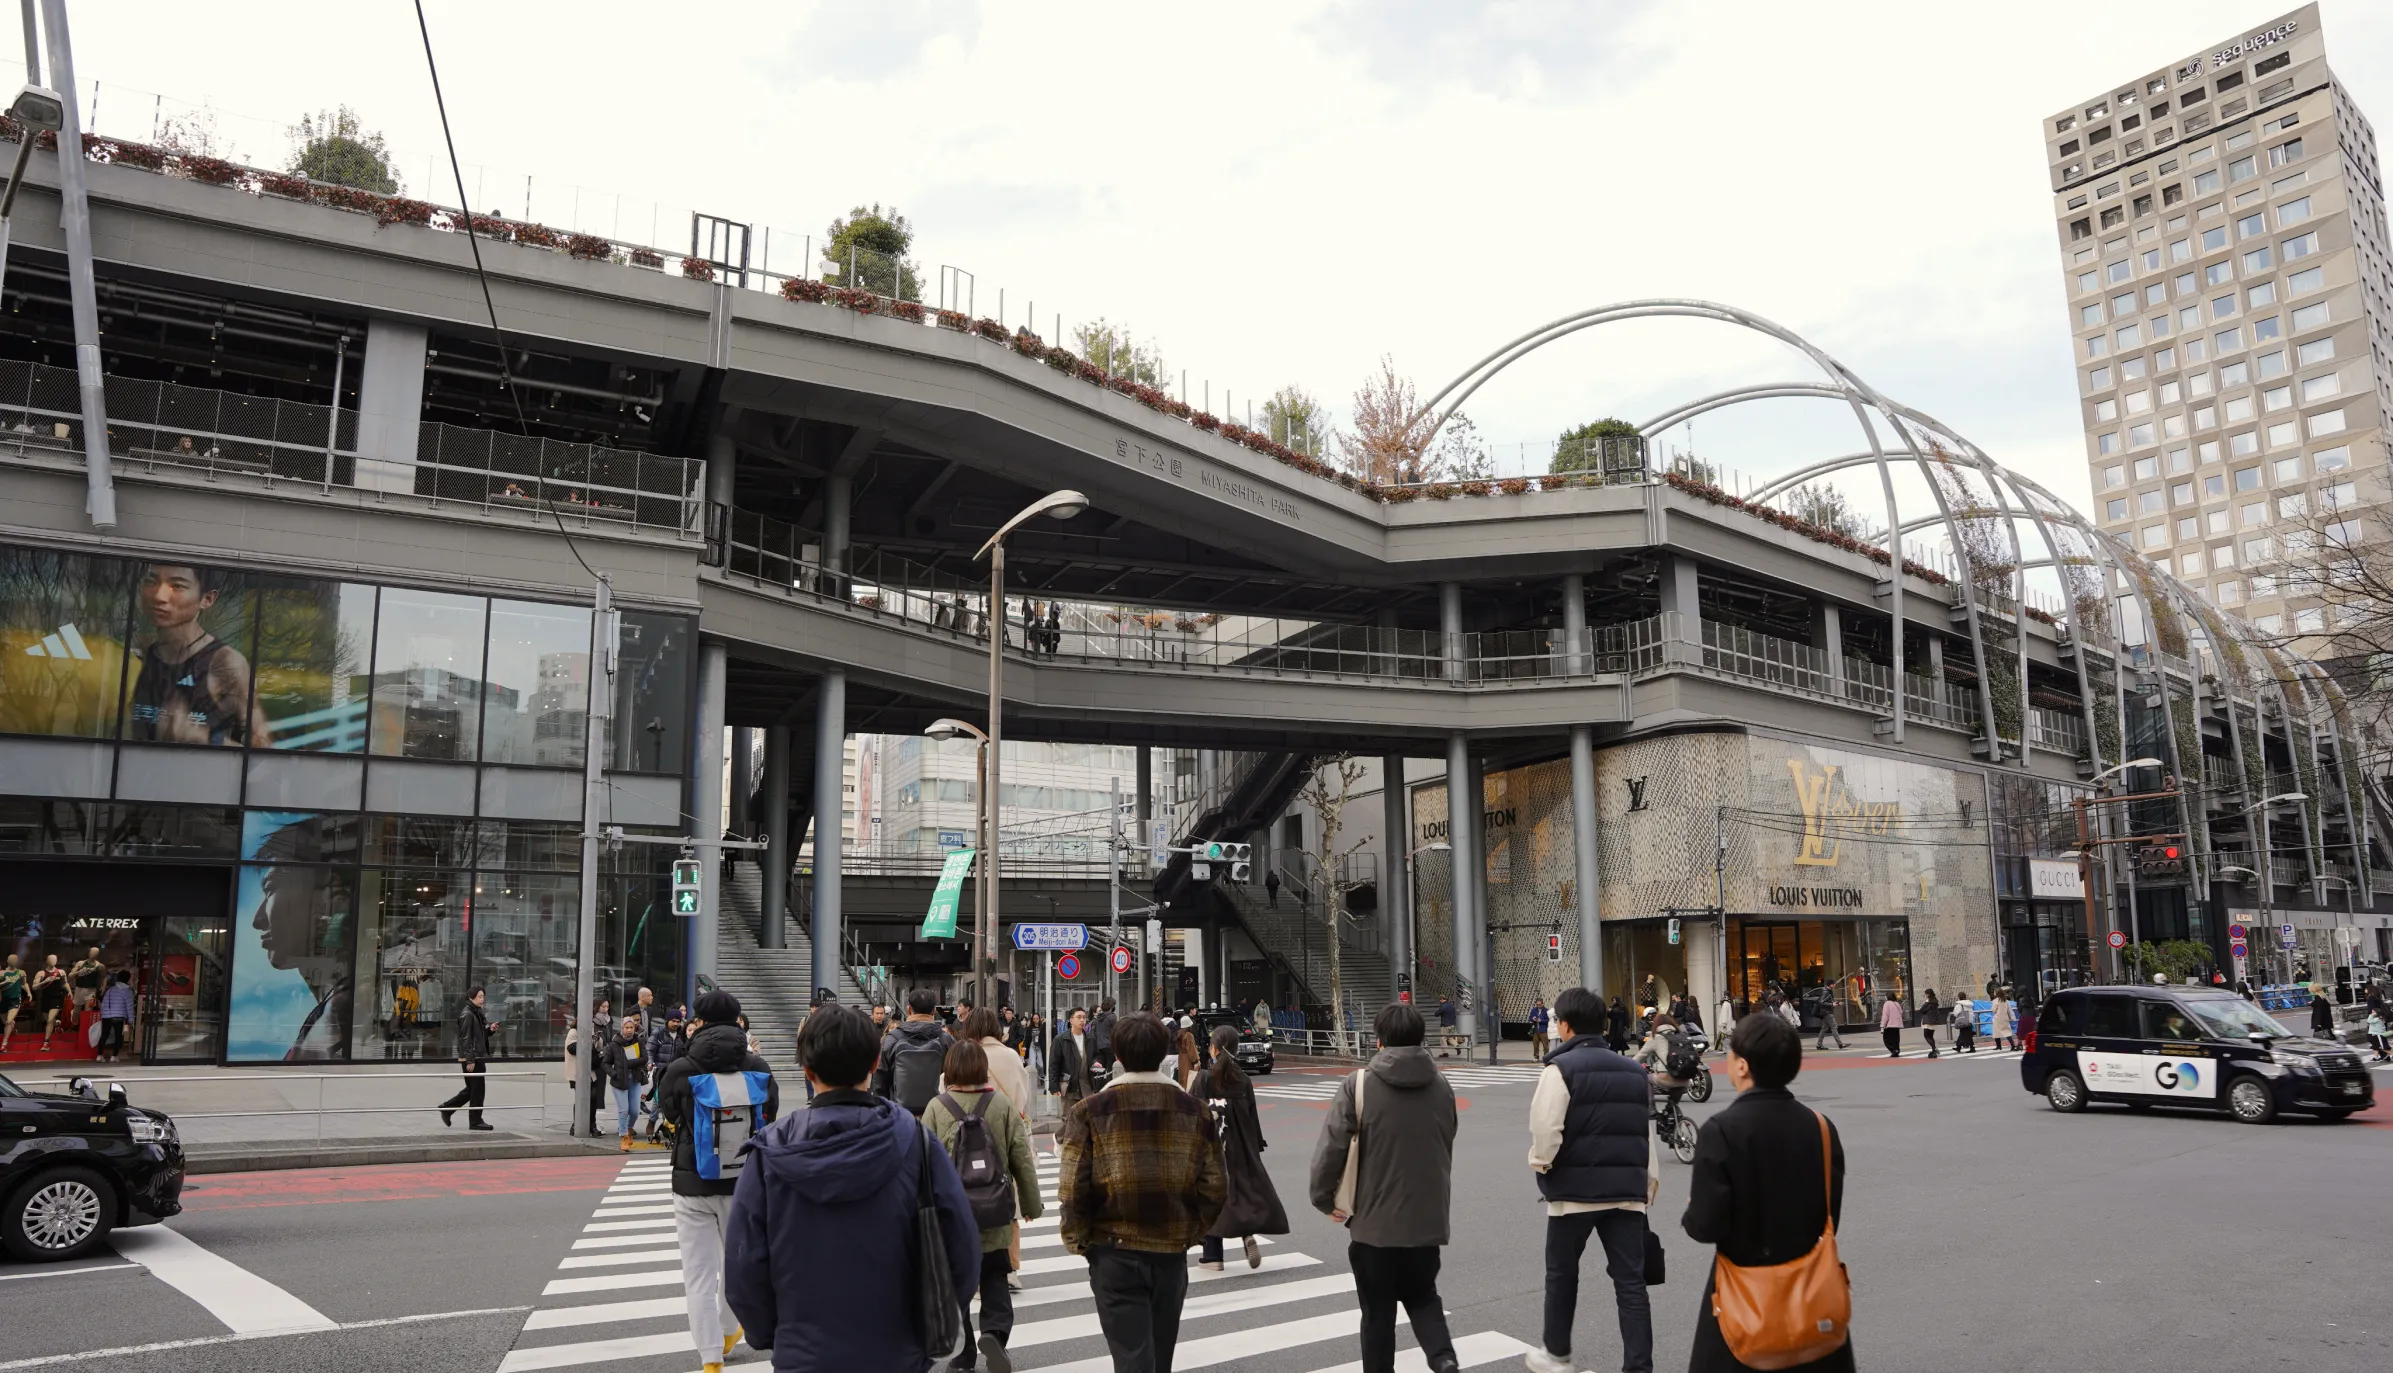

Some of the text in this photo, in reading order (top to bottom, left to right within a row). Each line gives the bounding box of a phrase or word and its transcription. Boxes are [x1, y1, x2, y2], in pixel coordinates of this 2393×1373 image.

[2212, 19, 2298, 65] sequence
[1115, 437, 1301, 520] 宮下公園 MIYASHITA PARK
[2040, 870, 2075, 887] GUCCI
[1770, 886, 1863, 908] LOUIS VUITTON
[89, 918, 140, 929] TERREX
[1022, 931, 1036, 941] 305
[1039, 926, 1079, 938] 明治通り
[2282, 925, 2292, 936] P
[1067, 938, 1080, 946] Ave.
[2111, 935, 2122, 944] 50
[1115, 954, 1126, 966] 40
[2155, 1061, 2199, 1091] GO
